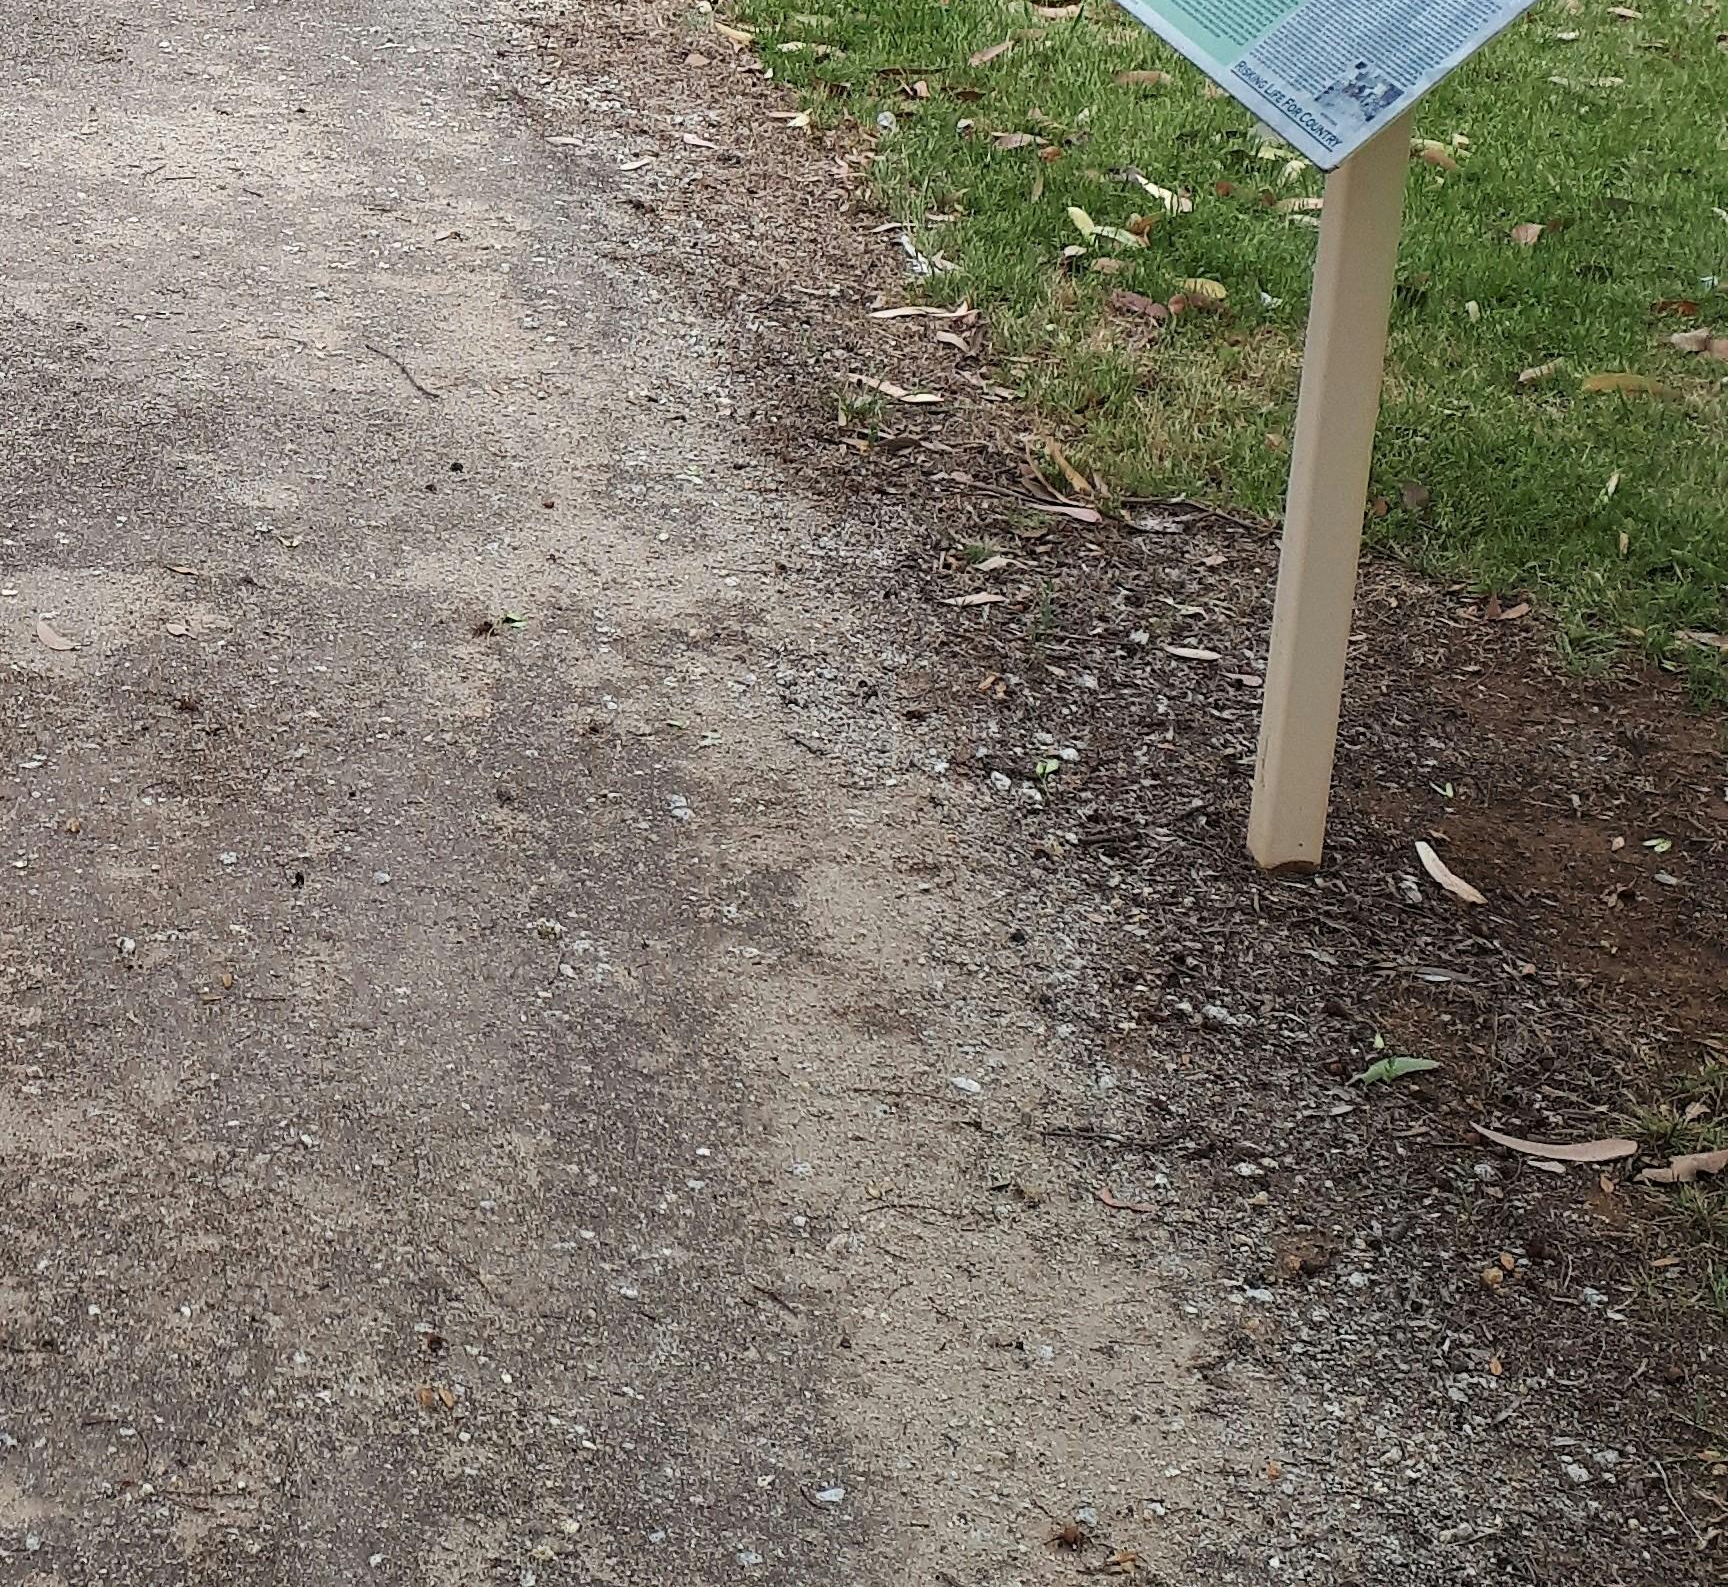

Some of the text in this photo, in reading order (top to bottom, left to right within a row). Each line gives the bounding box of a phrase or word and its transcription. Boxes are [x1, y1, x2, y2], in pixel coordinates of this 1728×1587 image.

[1233, 60, 1269, 89] RISKING
[1262, 82, 1287, 103] LIFE
[1280, 97, 1304, 117] FOR
[1297, 110, 1345, 149] COUNTRY
